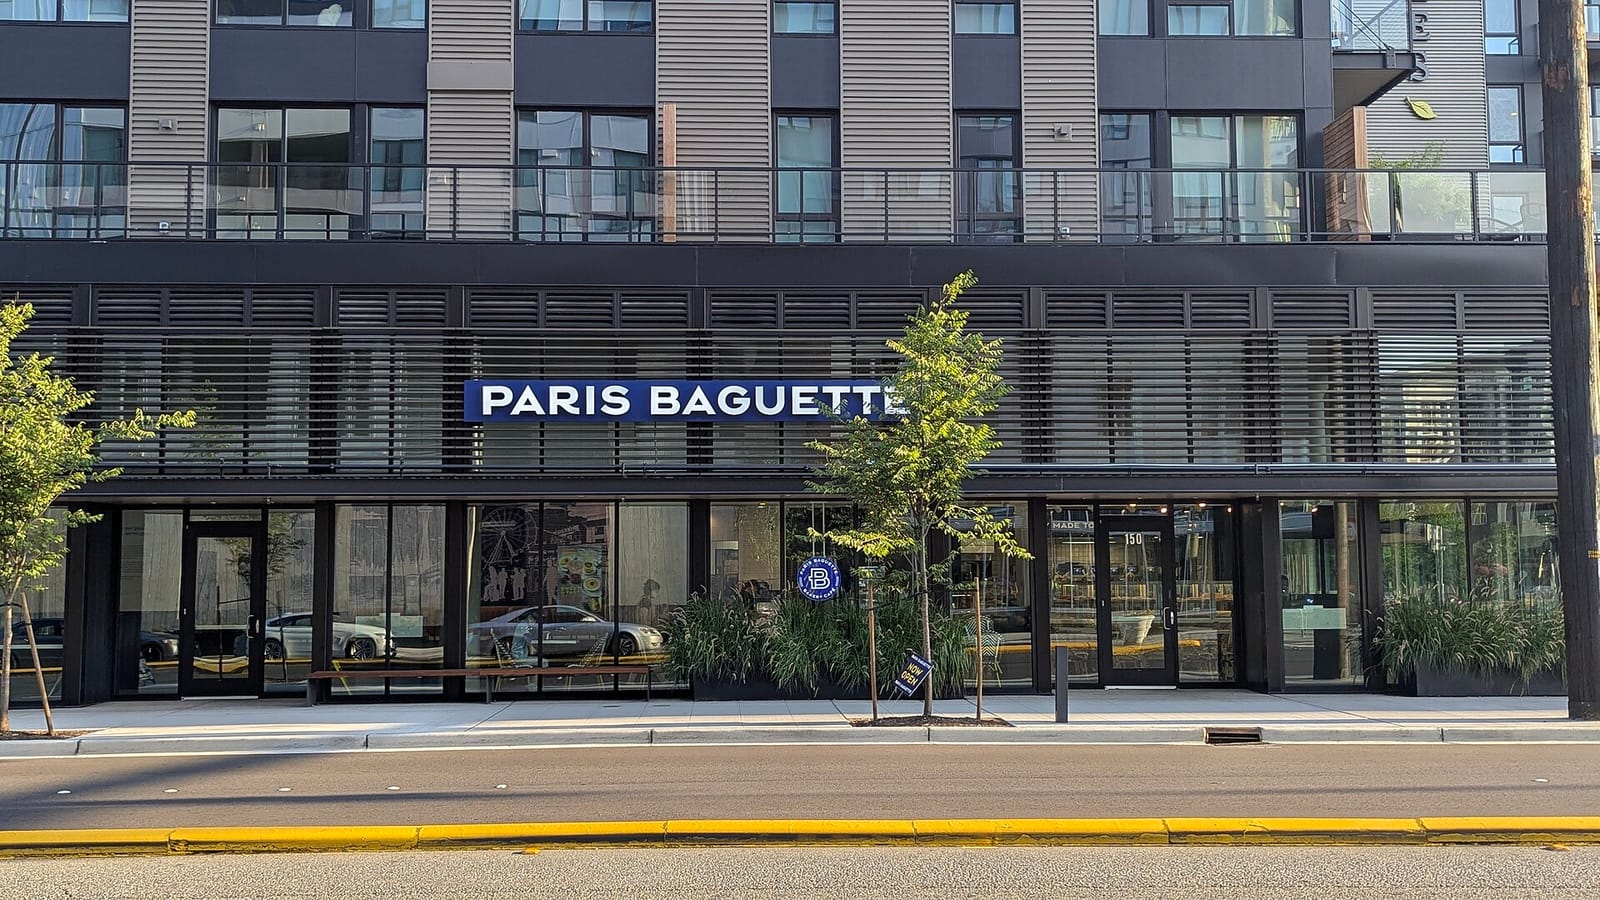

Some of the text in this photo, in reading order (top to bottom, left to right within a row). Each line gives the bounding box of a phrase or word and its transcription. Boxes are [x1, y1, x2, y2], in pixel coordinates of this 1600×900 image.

[481, 385, 911, 415] PARIS BAGUETTE
[1052, 522, 1095, 530] MADE TO
[1124, 533, 1142, 545] 150
[800, 558, 838, 575] PARIS BAGUETTE
[808, 567, 831, 590] B
[907, 663, 923, 676] NOW
[901, 671, 918, 685] OPEN
